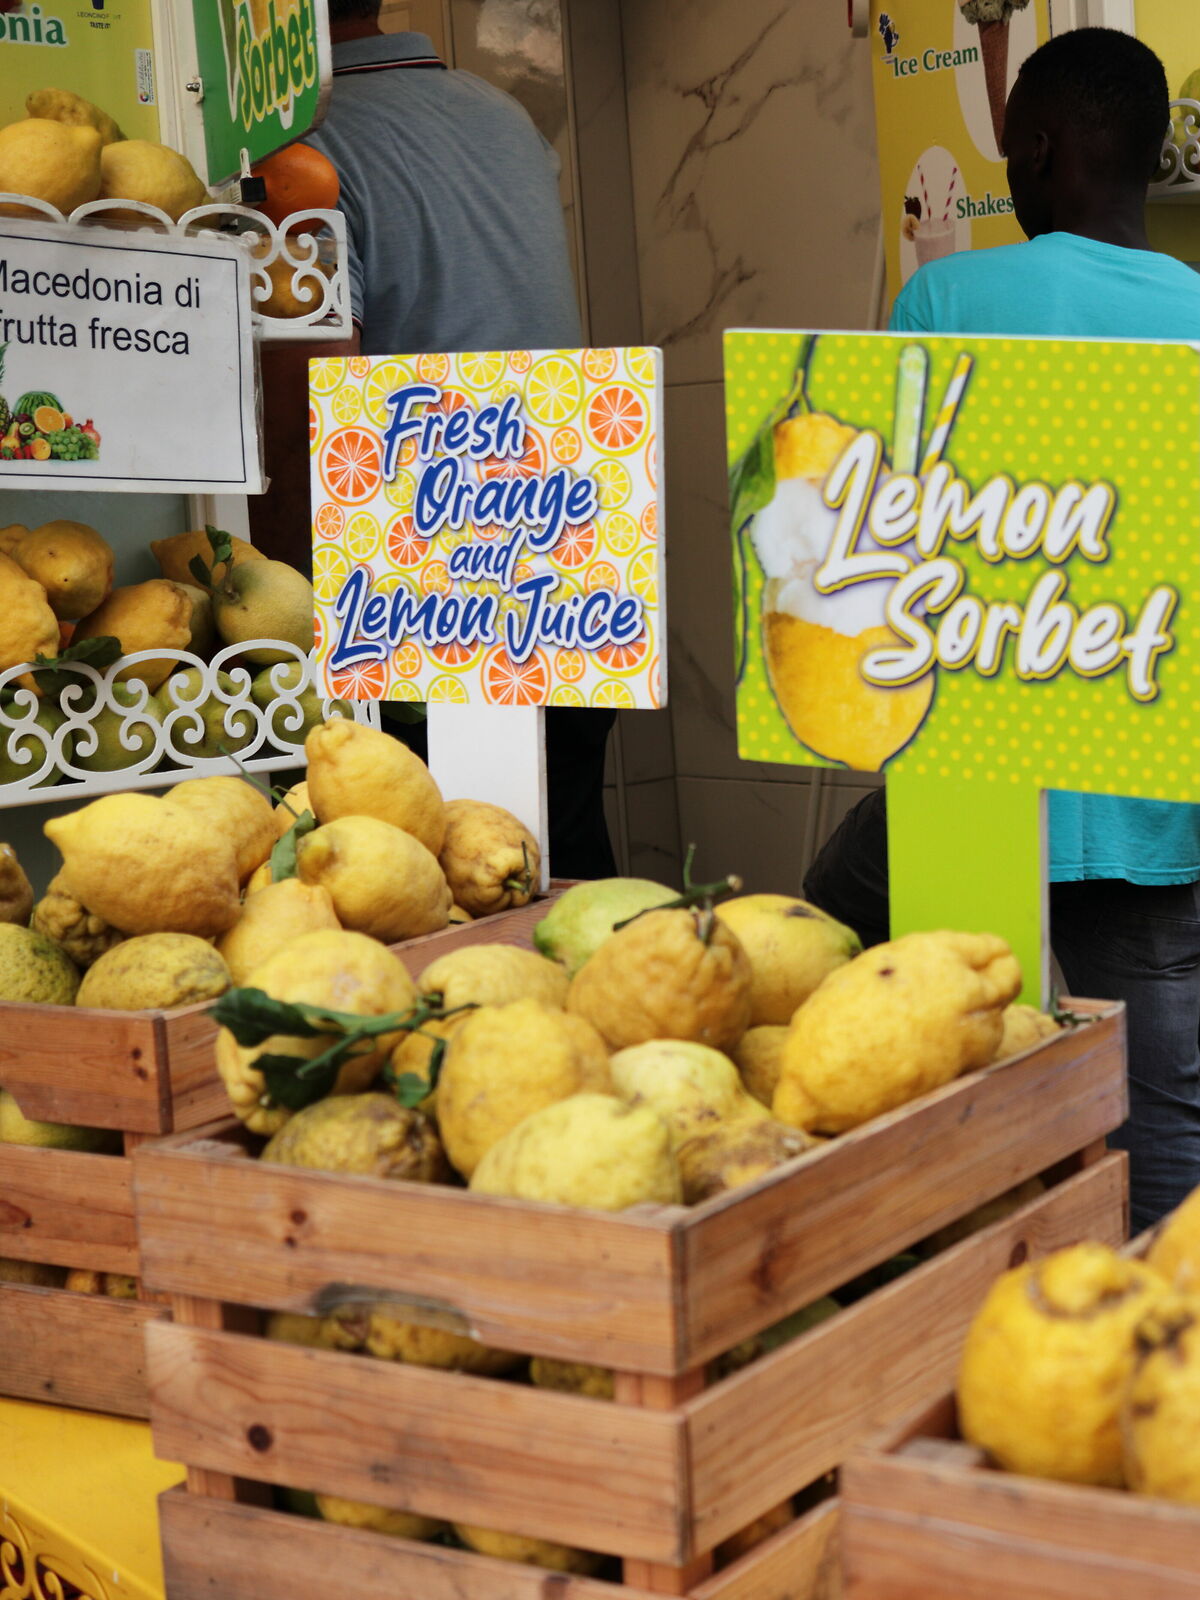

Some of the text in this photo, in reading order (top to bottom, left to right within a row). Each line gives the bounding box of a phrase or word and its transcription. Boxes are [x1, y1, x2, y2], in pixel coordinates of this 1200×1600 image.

[238, 0, 315, 126] Sorbet
[894, 46, 979, 77] Ice Cream
[956, 193, 1015, 219] Shakes
[0, 259, 200, 309] acedonia di
[88, 317, 190, 355] fresca
[384, 386, 524, 480] Fresh
[414, 459, 598, 549] Orange
[814, 429, 1119, 594] Lemon
[449, 526, 527, 590] and
[330, 567, 644, 670] Lemon Juice
[862, 558, 1178, 702] Sorbet
